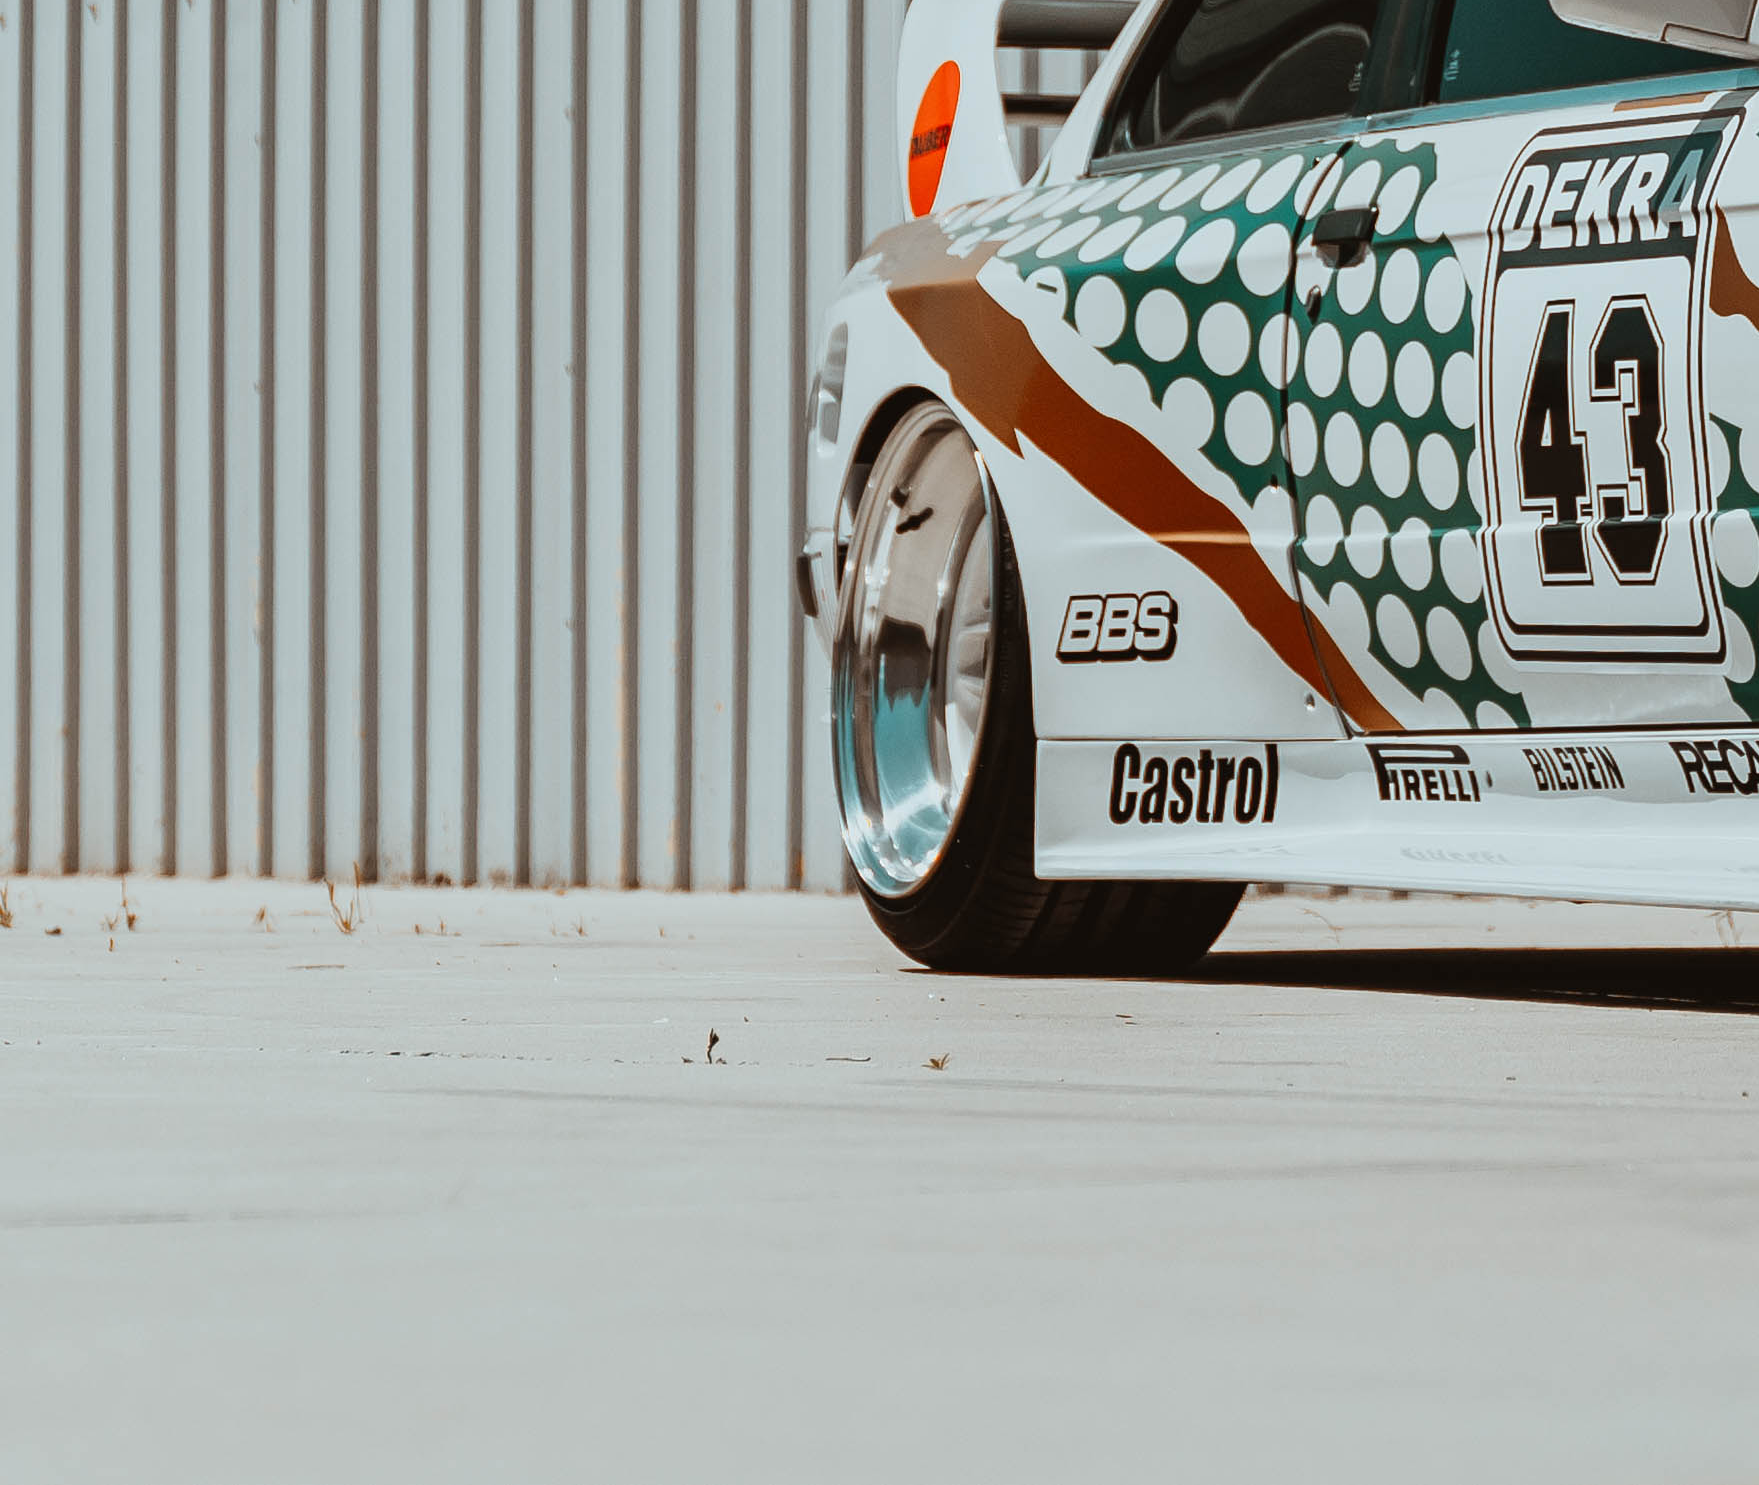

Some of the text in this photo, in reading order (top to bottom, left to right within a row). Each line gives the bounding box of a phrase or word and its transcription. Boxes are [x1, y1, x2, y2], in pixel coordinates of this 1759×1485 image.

[1502, 148, 1704, 253] DEKRA
[1515, 295, 1668, 587] 43
[1056, 590, 1178, 663] BBS
[1109, 743, 1279, 824] Castrol
[1365, 743, 1481, 802] PIRELLI
[1522, 746, 1625, 791] BILSTEIN
